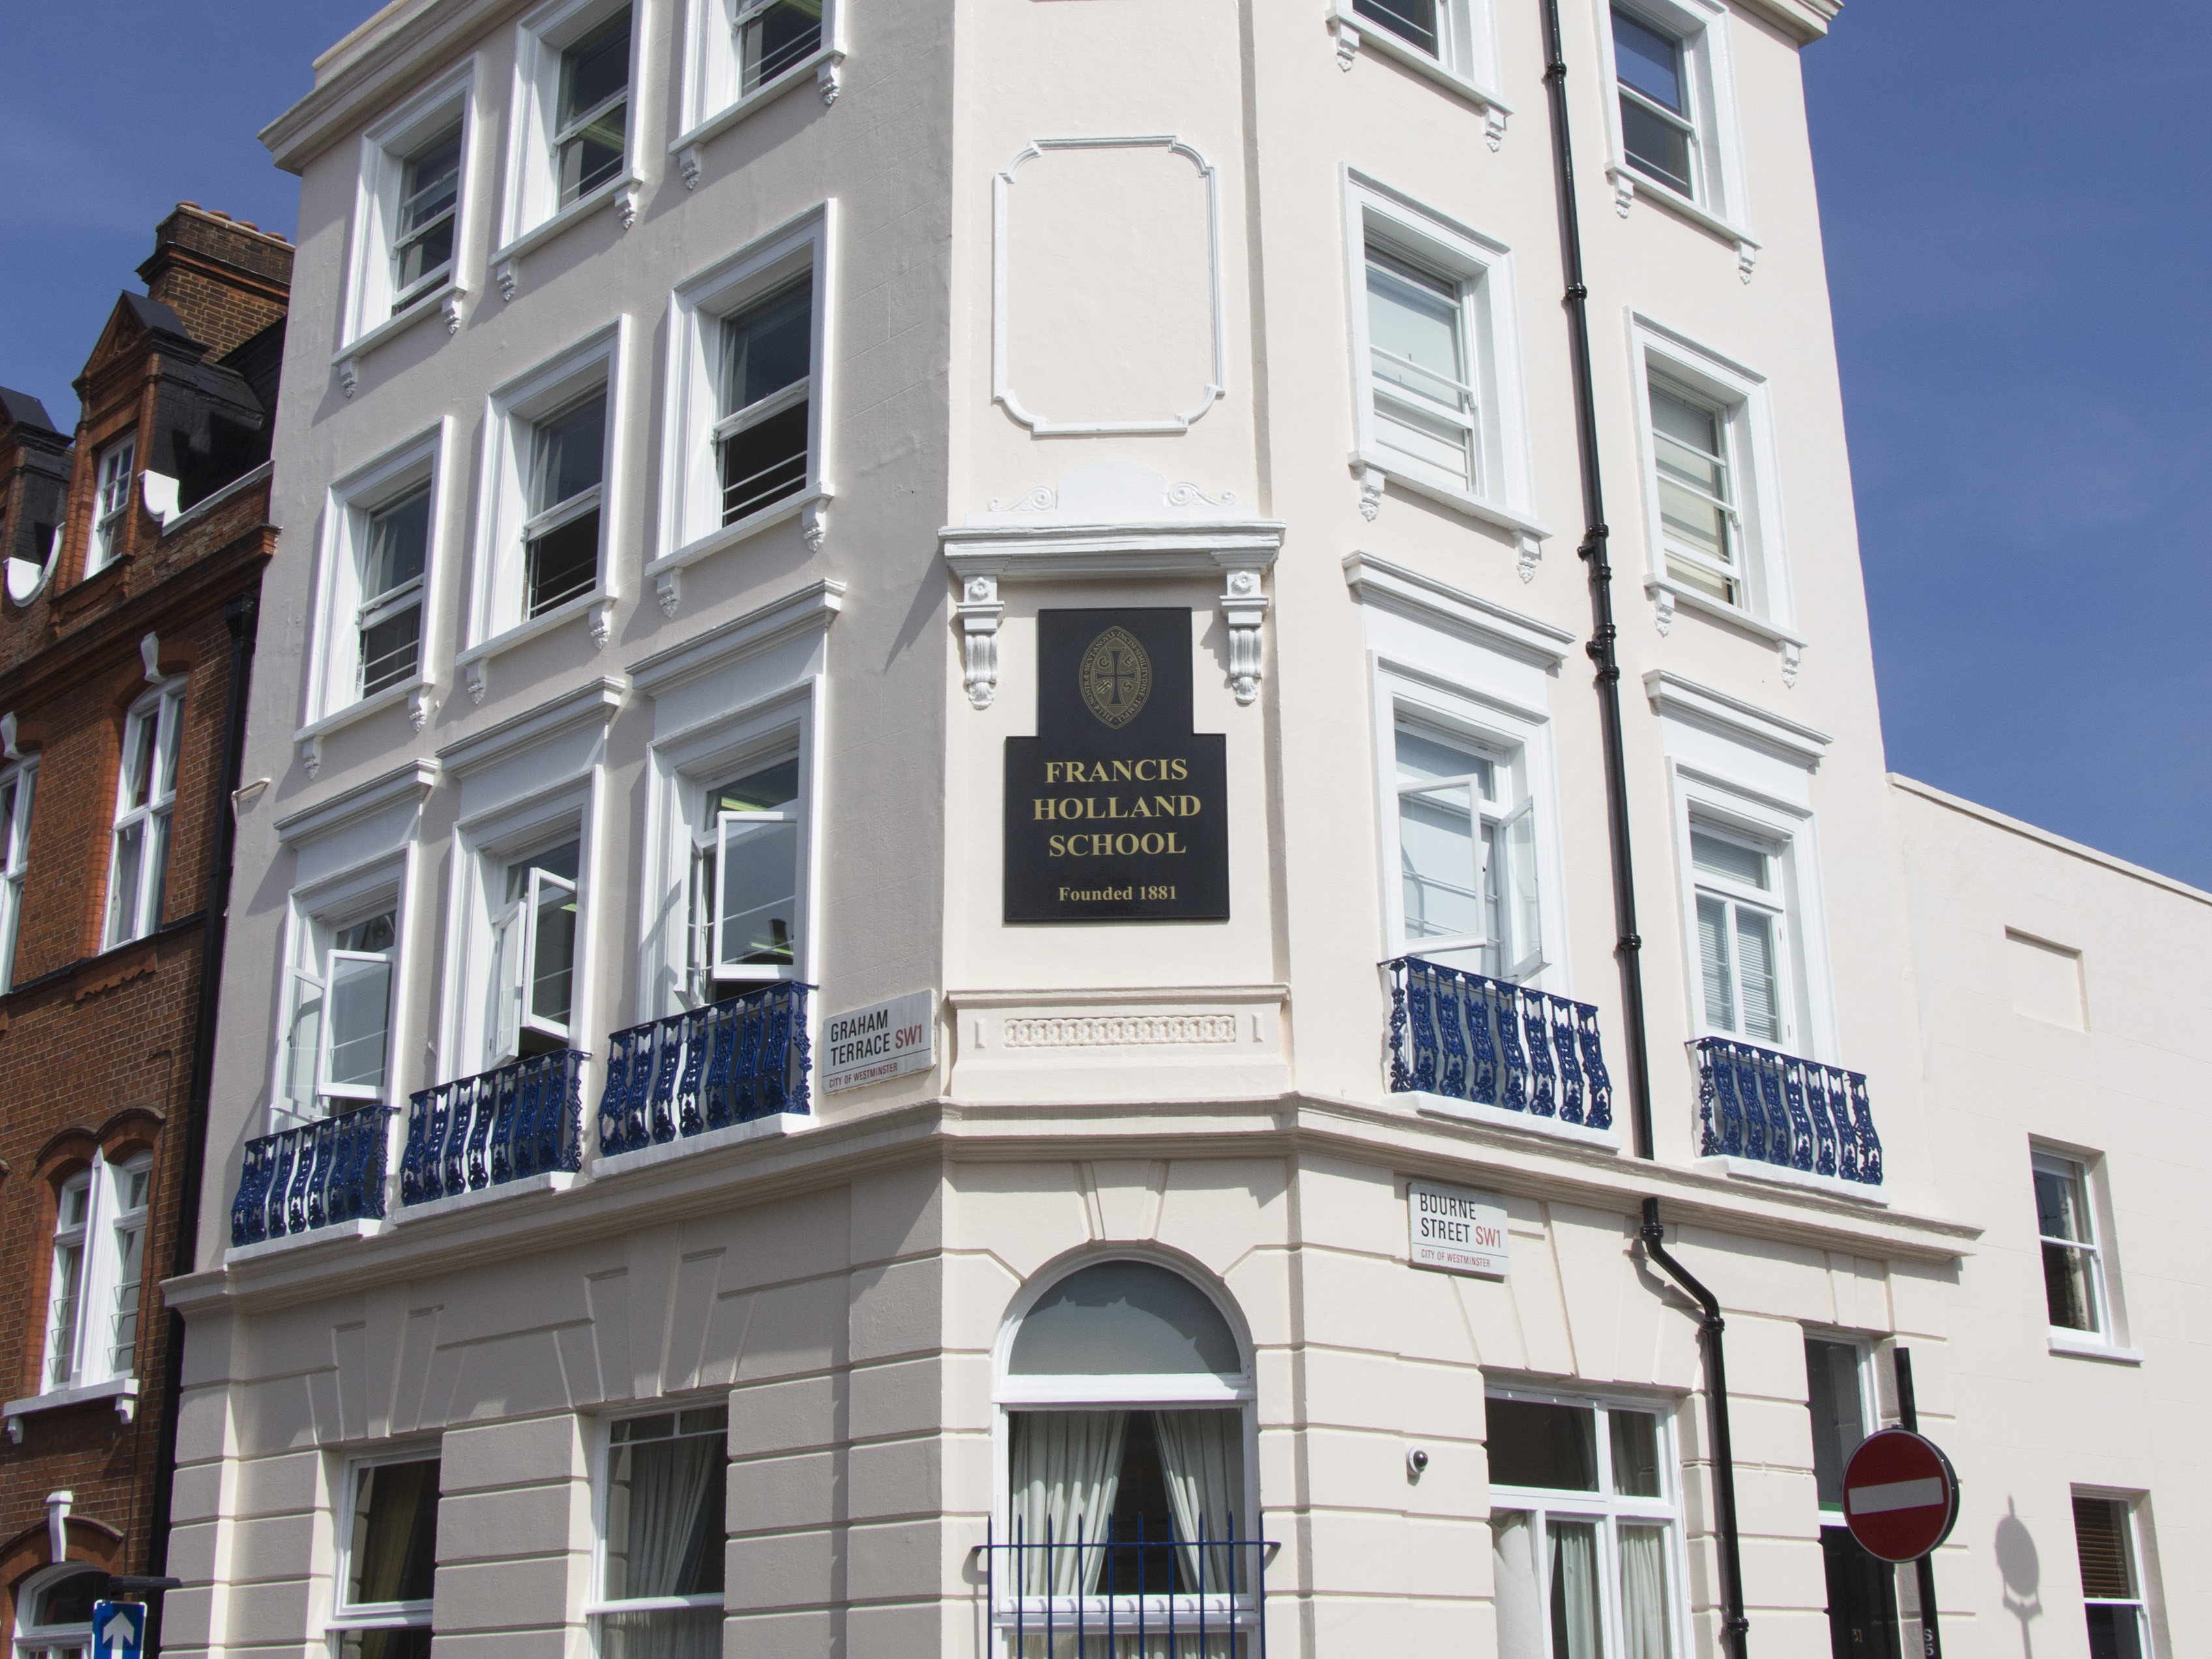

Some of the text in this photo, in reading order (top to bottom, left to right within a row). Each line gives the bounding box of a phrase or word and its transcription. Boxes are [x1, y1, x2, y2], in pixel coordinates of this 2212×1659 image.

[1122, 654, 1135, 667] E
[1045, 758, 1189, 784] FRANCIS
[1032, 795, 1202, 821] HOLLAND
[1049, 832, 1187, 857] SCHOOL
[1058, 886, 1177, 902] Founded 1881
[831, 1009, 888, 1043] GRAHAM
[831, 1024, 922, 1066] TERRACE SW1
[829, 1062, 897, 1088] CITY OF WESTMINSTER
[1419, 1192, 1476, 1220] BOURNE
[1421, 1217, 1501, 1248] STREET SW1
[1421, 1249, 1491, 1268] CITY OF WESTMINSTER
